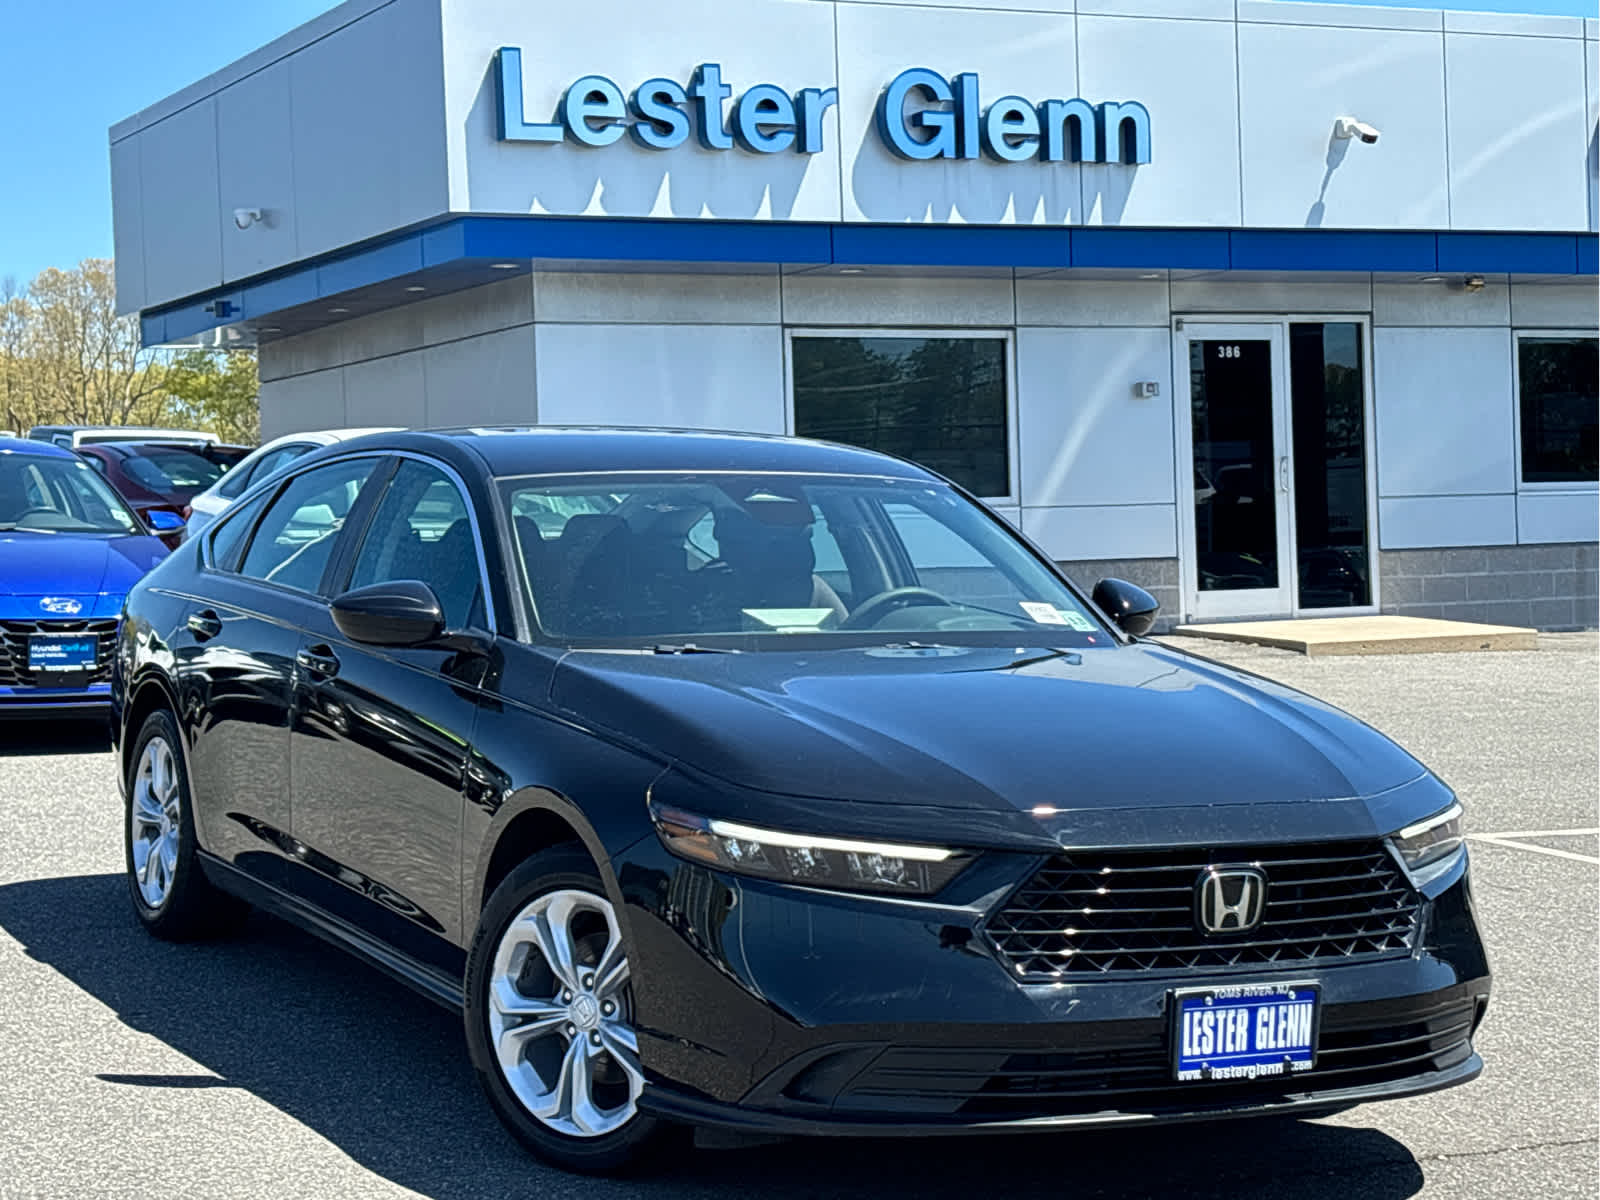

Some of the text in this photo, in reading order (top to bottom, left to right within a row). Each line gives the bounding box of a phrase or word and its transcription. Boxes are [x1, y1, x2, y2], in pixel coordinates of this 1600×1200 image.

[496, 46, 1152, 165] Lester Glenn
[1218, 345, 1241, 358] 386
[1214, 987, 1242, 999] TOMS
[1182, 1003, 1313, 1057] LESTER GLENN
